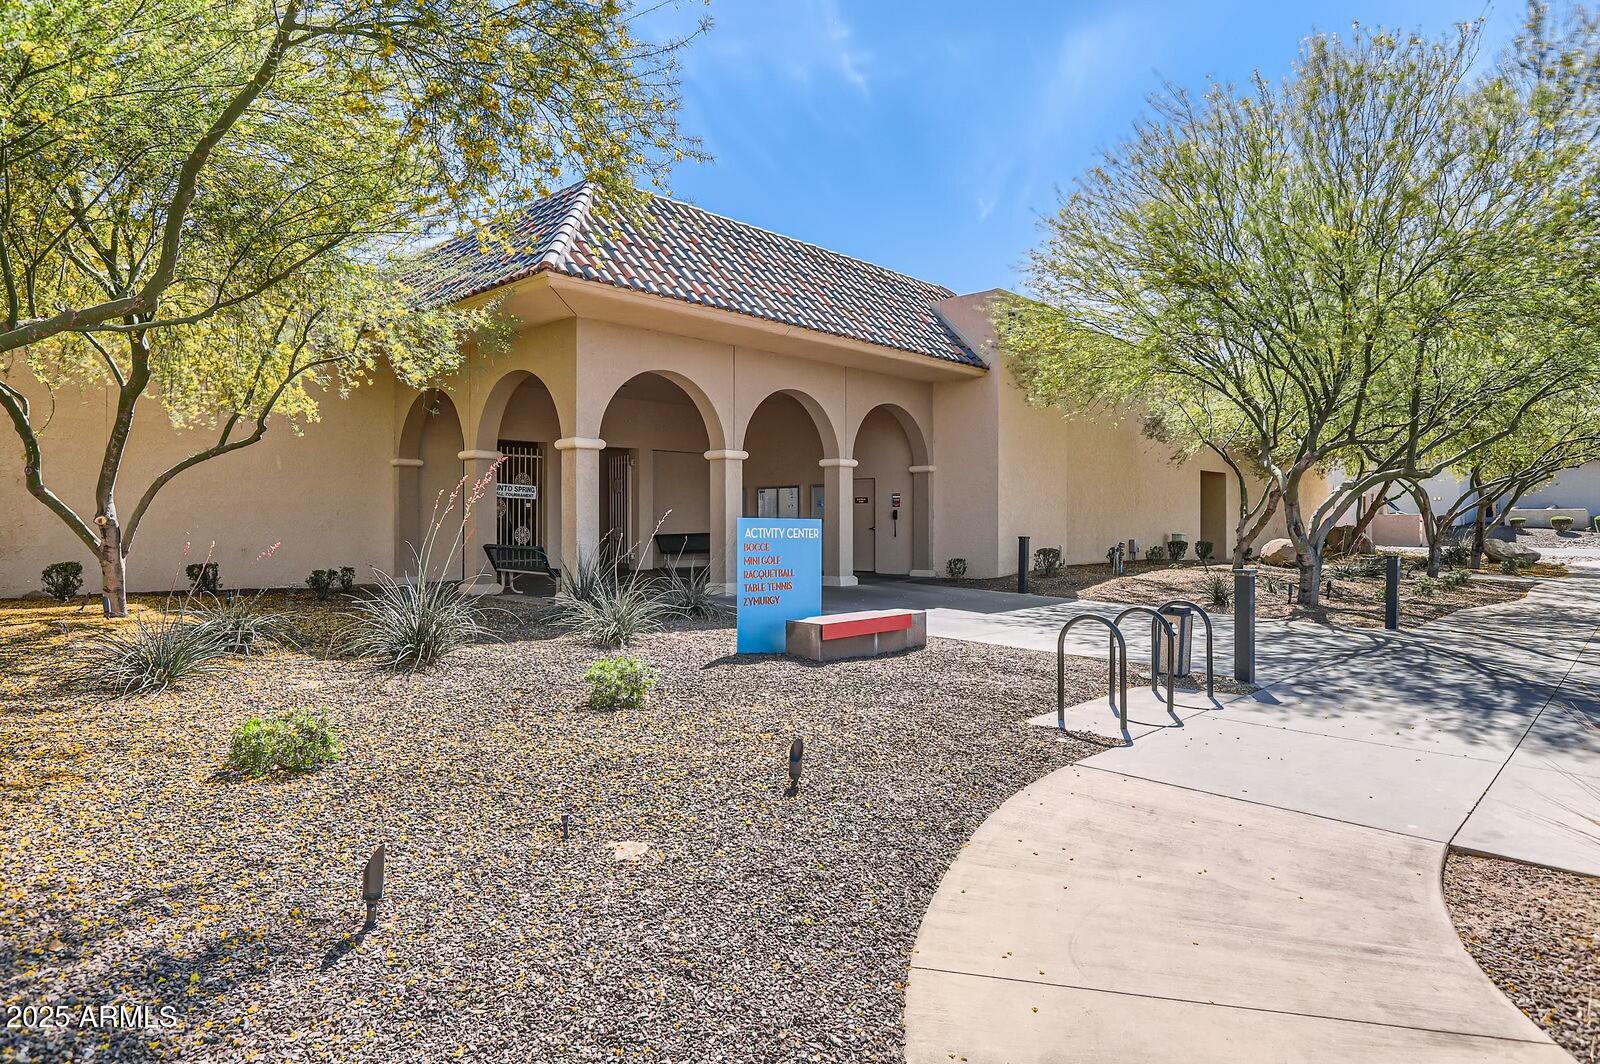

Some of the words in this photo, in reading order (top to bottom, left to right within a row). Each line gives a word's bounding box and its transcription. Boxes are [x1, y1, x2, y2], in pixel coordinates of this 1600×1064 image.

[744, 527, 785, 539] ACTIVITY
[787, 528, 818, 539] CENTER
[743, 543, 769, 552] BOCCE
[743, 556, 760, 566] MINI
[761, 555, 781, 565] GOLF
[743, 568, 795, 579] RACQUETBALL
[743, 583, 766, 592] TABLE
[767, 581, 793, 591] TENNIS
[743, 595, 780, 607] ZYMURGY
